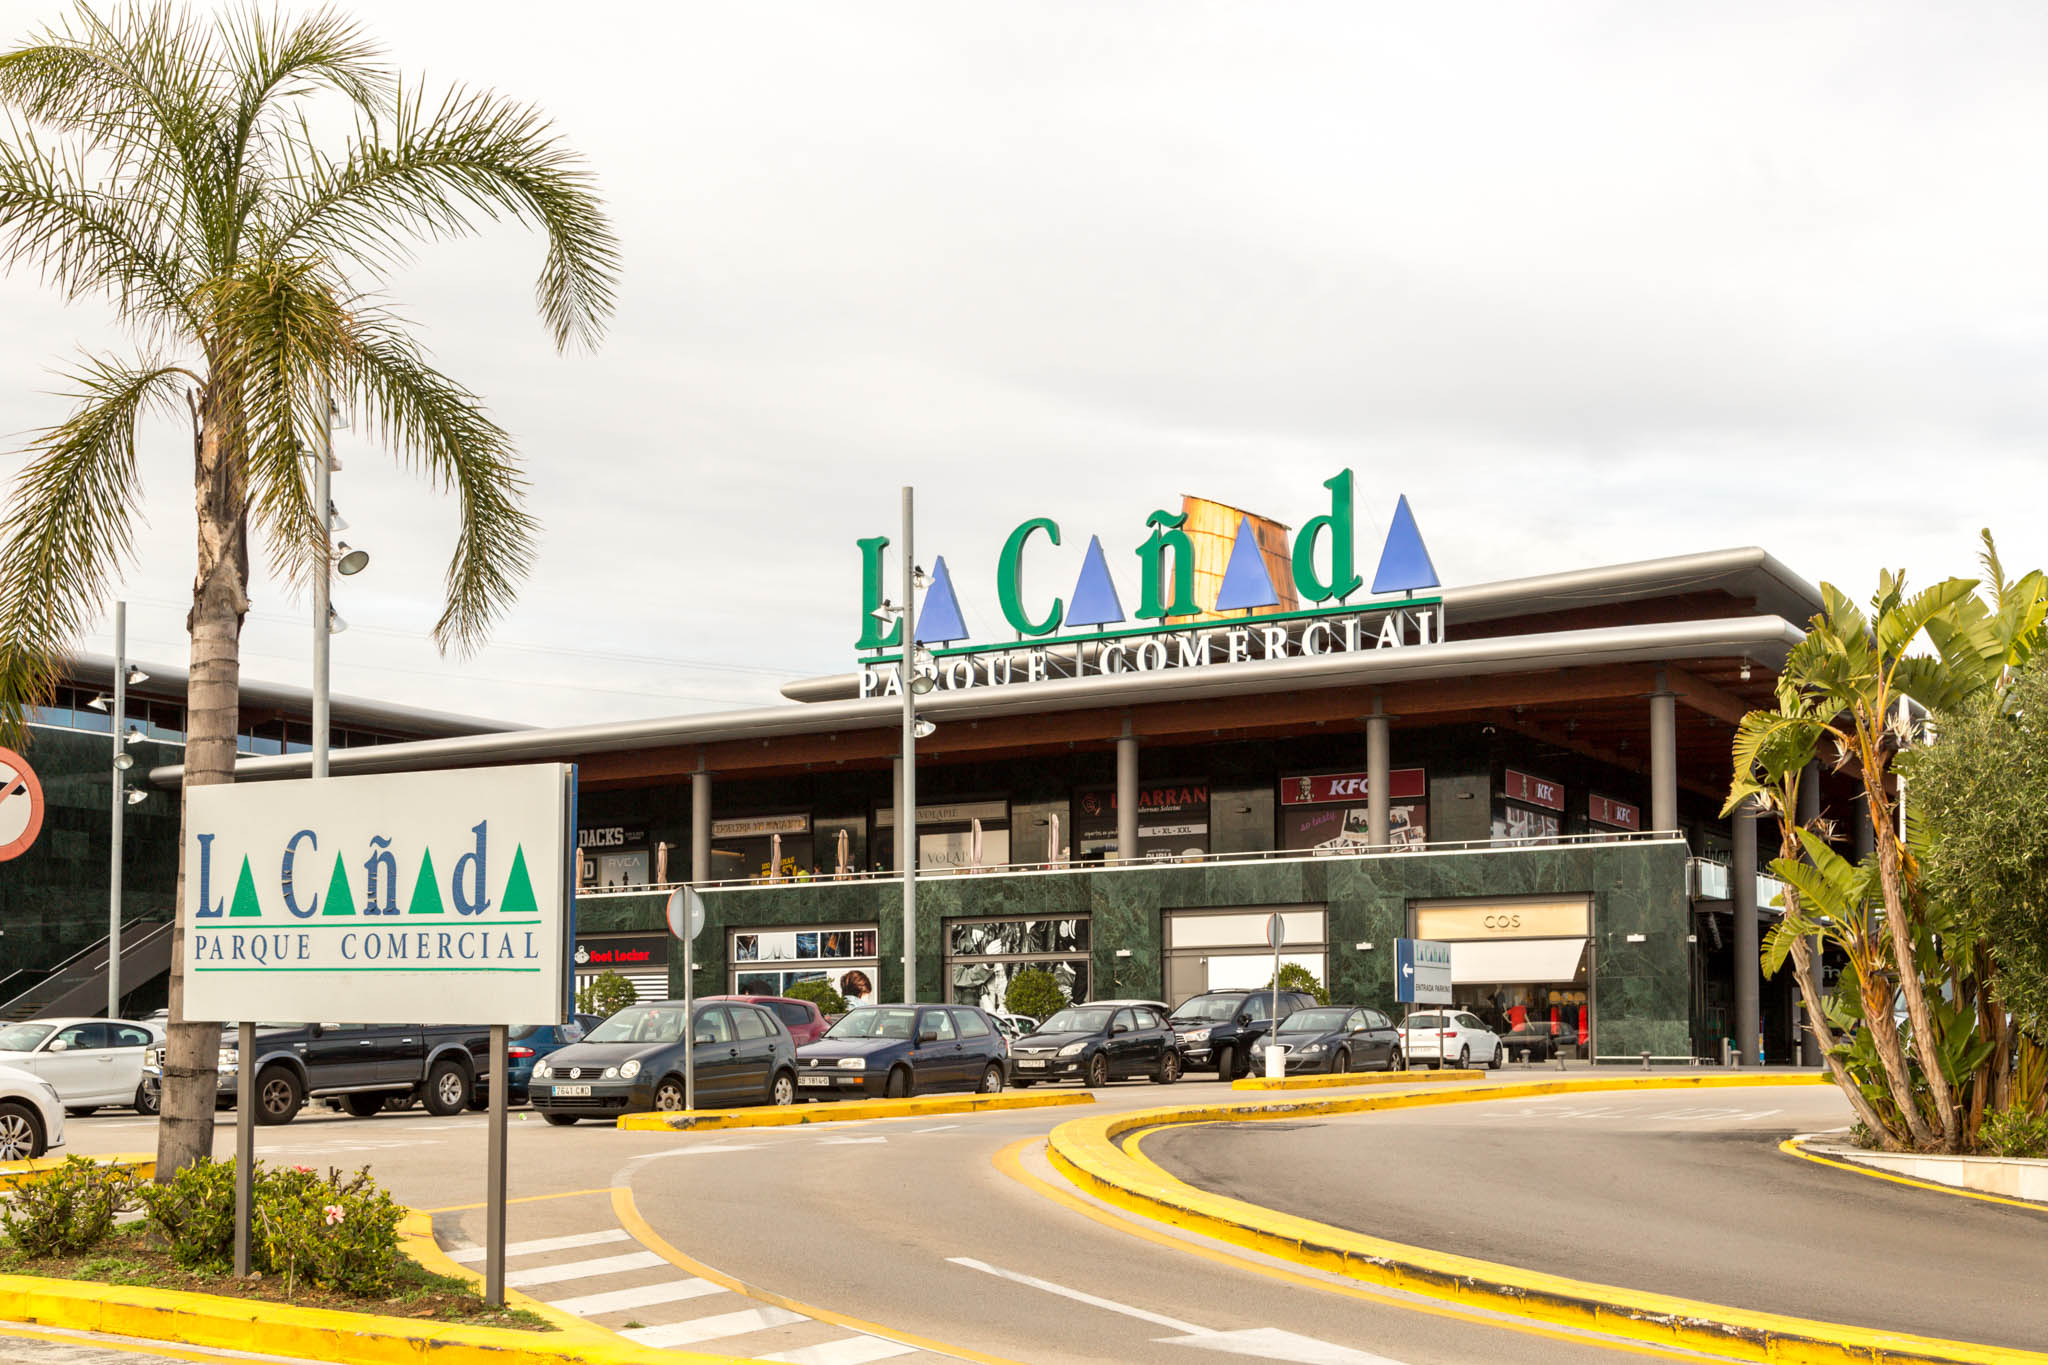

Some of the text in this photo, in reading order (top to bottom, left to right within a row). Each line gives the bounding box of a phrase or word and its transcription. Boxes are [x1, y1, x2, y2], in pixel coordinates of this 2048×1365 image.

[1099, 611, 1443, 676] COMERCIAL
[1328, 778, 1368, 796] KFC
[1536, 783, 1554, 801] KFC
[1615, 805, 1631, 823] KFC
[578, 827, 624, 847] DACKS
[1484, 914, 1521, 929] COS
[194, 931, 540, 965] PARQUE COMERCIAL
[590, 948, 649, 962] Foot Locker
[1416, 984, 1434, 992] ENTRADA
